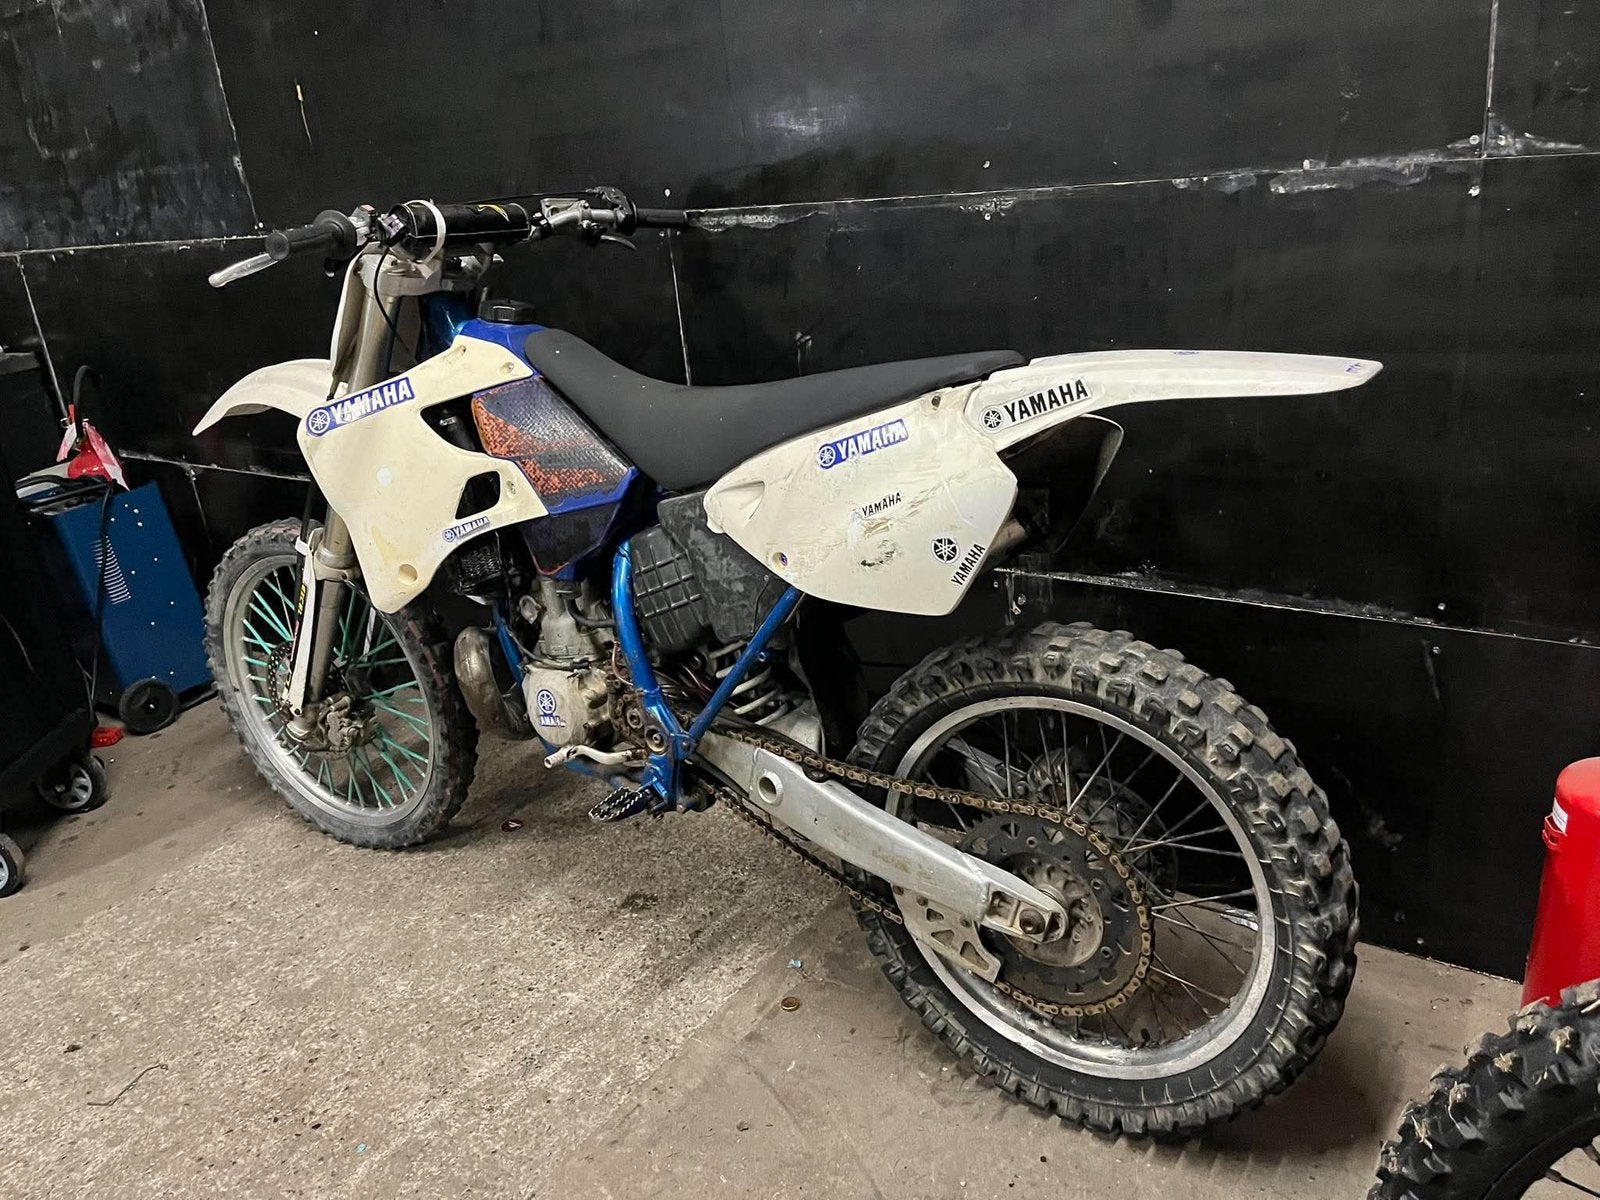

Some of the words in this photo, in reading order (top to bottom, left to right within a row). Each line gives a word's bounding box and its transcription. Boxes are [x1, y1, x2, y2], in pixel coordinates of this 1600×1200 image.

[330, 379, 412, 425] YAMAHA
[1003, 379, 1088, 422] YAMAHA
[836, 421, 906, 460] YAMAHA
[862, 492, 902, 516] YAMAHA
[453, 517, 489, 537] YAMAHA
[951, 544, 986, 585] YAMAHA
